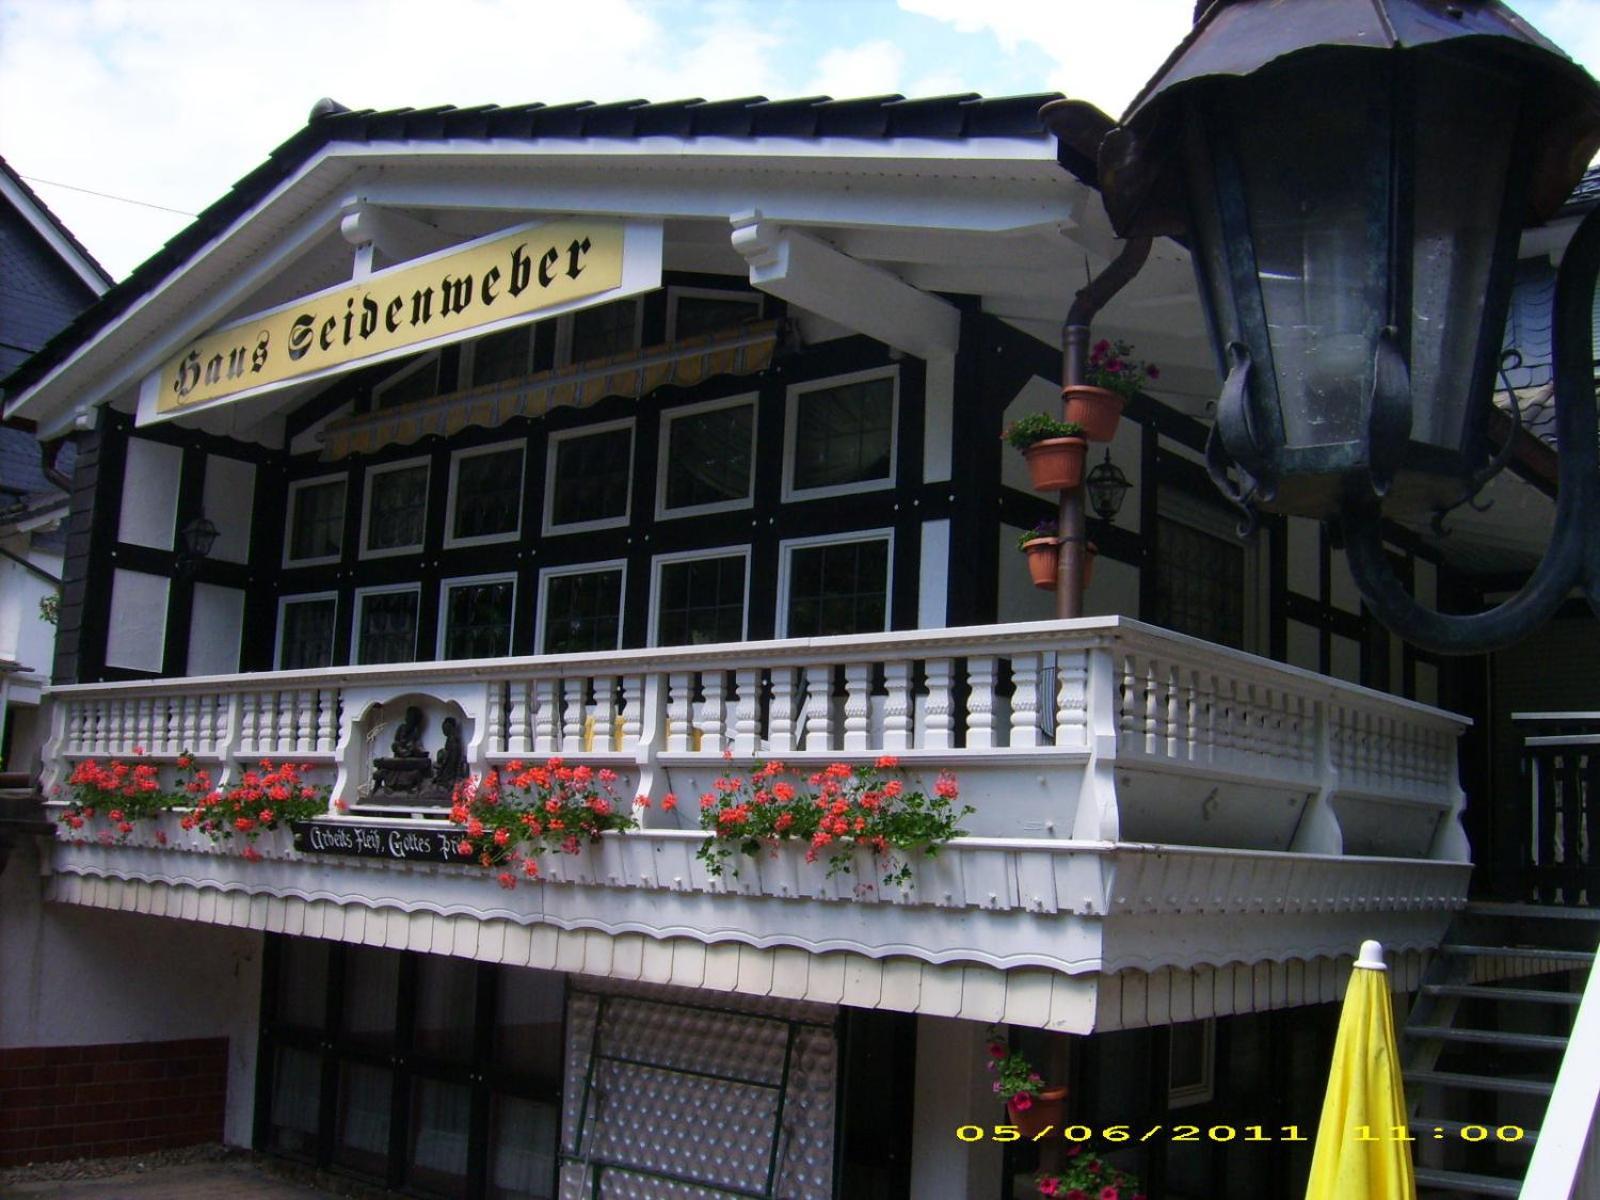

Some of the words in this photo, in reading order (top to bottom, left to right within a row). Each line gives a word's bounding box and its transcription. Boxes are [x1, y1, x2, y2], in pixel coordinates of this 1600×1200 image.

[173, 330, 270, 405] Haus
[288, 236, 592, 361] Seidenweber
[388, 830, 431, 857] Gottes
